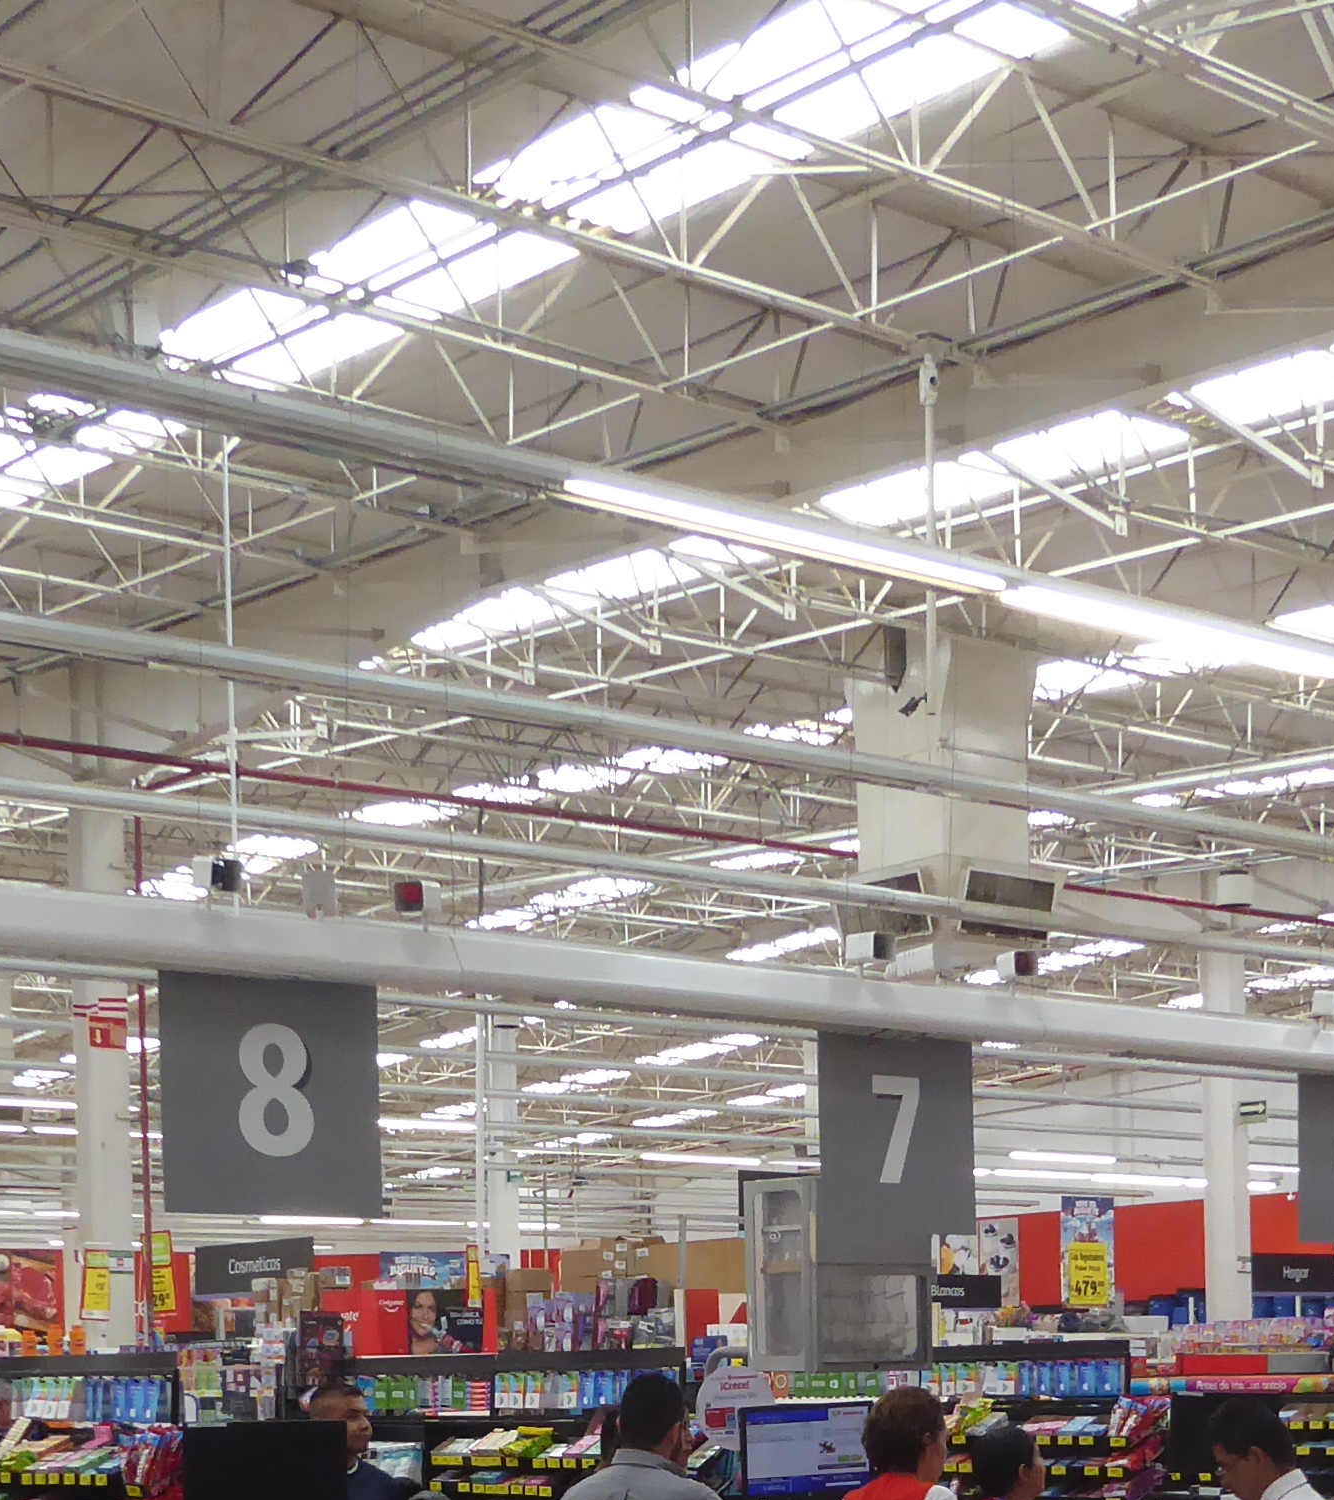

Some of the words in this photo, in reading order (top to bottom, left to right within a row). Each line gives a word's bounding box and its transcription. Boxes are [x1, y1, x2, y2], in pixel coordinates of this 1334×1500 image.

[238, 1023, 314, 1156] 8
[872, 1074, 920, 1184] 7
[1282, 1265, 1310, 1282] Hogar
